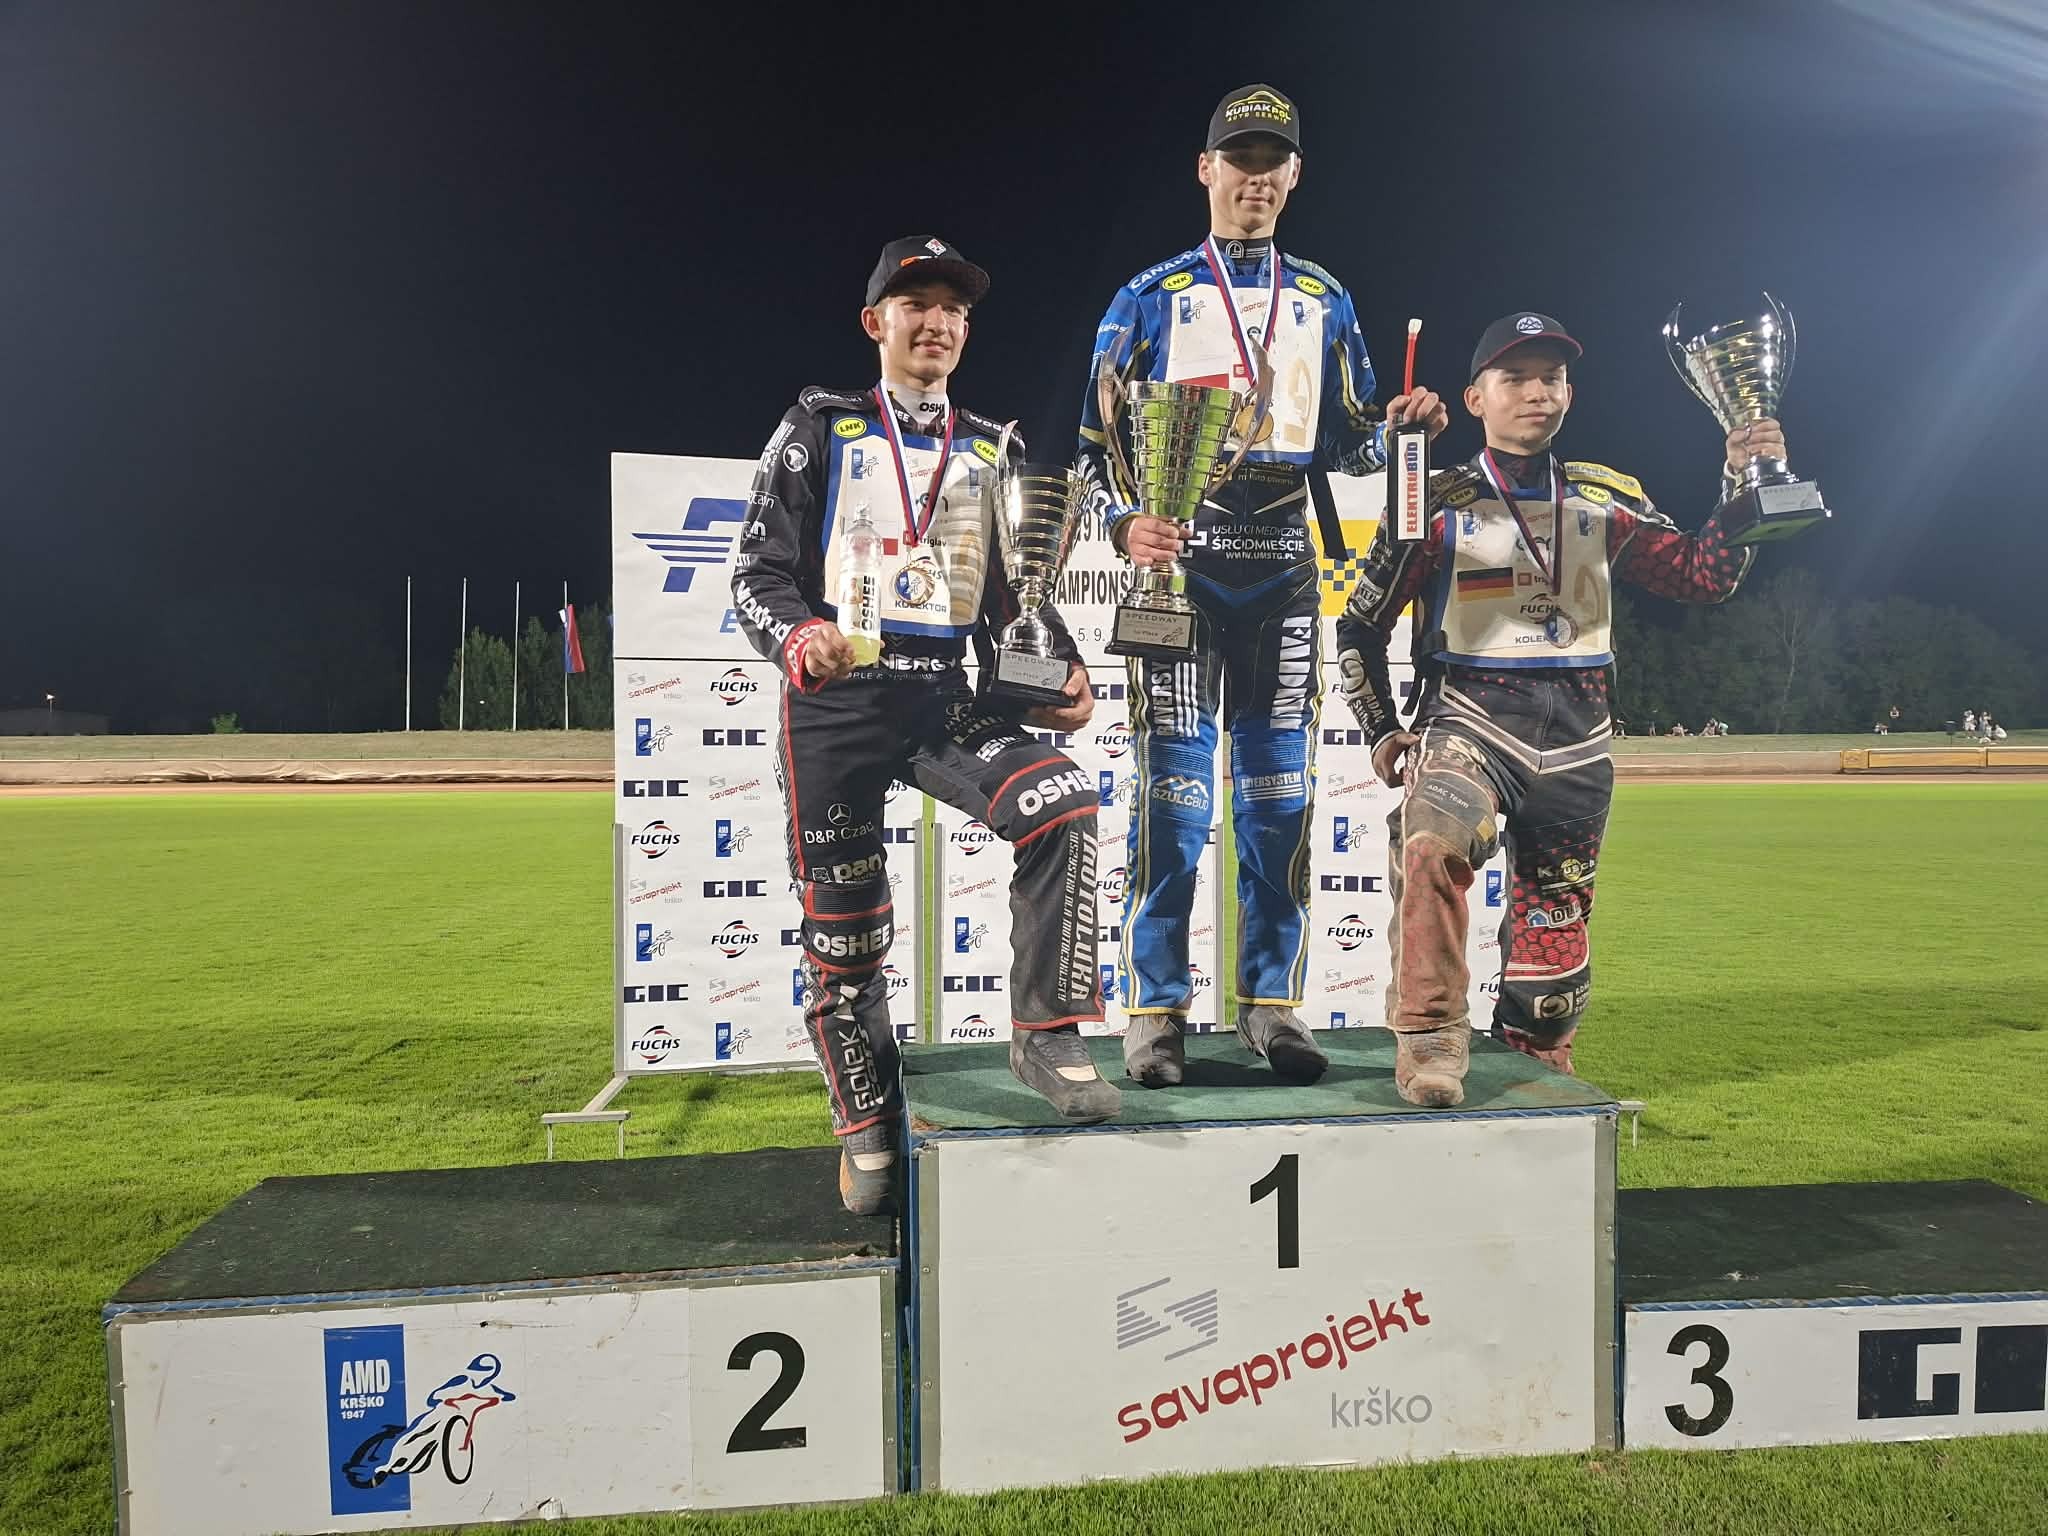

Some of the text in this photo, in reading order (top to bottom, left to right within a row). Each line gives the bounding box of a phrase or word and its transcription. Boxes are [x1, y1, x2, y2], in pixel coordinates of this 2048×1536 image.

[839, 421, 861, 433] LNK
[628, 677, 681, 699] savaprojekt
[709, 681, 759, 692] FUCHS
[1095, 735, 1130, 746] FUCH
[708, 778, 760, 801] savaprojekt
[1016, 768, 1096, 816] OSHE
[1327, 777, 1379, 797] savaprojekt
[631, 833, 681, 845] FUCHS
[804, 829, 836, 844] D&R
[951, 832, 995, 843] FUCHS
[629, 881, 683, 904] savaprojekt
[949, 878, 997, 899] savaprojekt
[1071, 831, 1099, 1001] MOTOLUKA
[711, 933, 760, 945] FUCHS
[812, 923, 891, 957] OSHEE
[1327, 927, 1374, 939] FUCHS
[708, 980, 761, 1004] savaprojekt
[1325, 974, 1376, 993] savaprojekt
[950, 1027, 996, 1039] FUCHS
[631, 1038, 681, 1051] FUCHS
[1249, 1153, 1300, 1269] 1
[1116, 1287, 1432, 1444] savaprojekt
[339, 1358, 391, 1396] AMD
[1664, 1323, 1735, 1437] 3
[340, 1393, 385, 1410] KRŠKO
[725, 1331, 808, 1454] 2
[340, 1408, 366, 1420] 1947
[1330, 1385, 1433, 1429] krško
